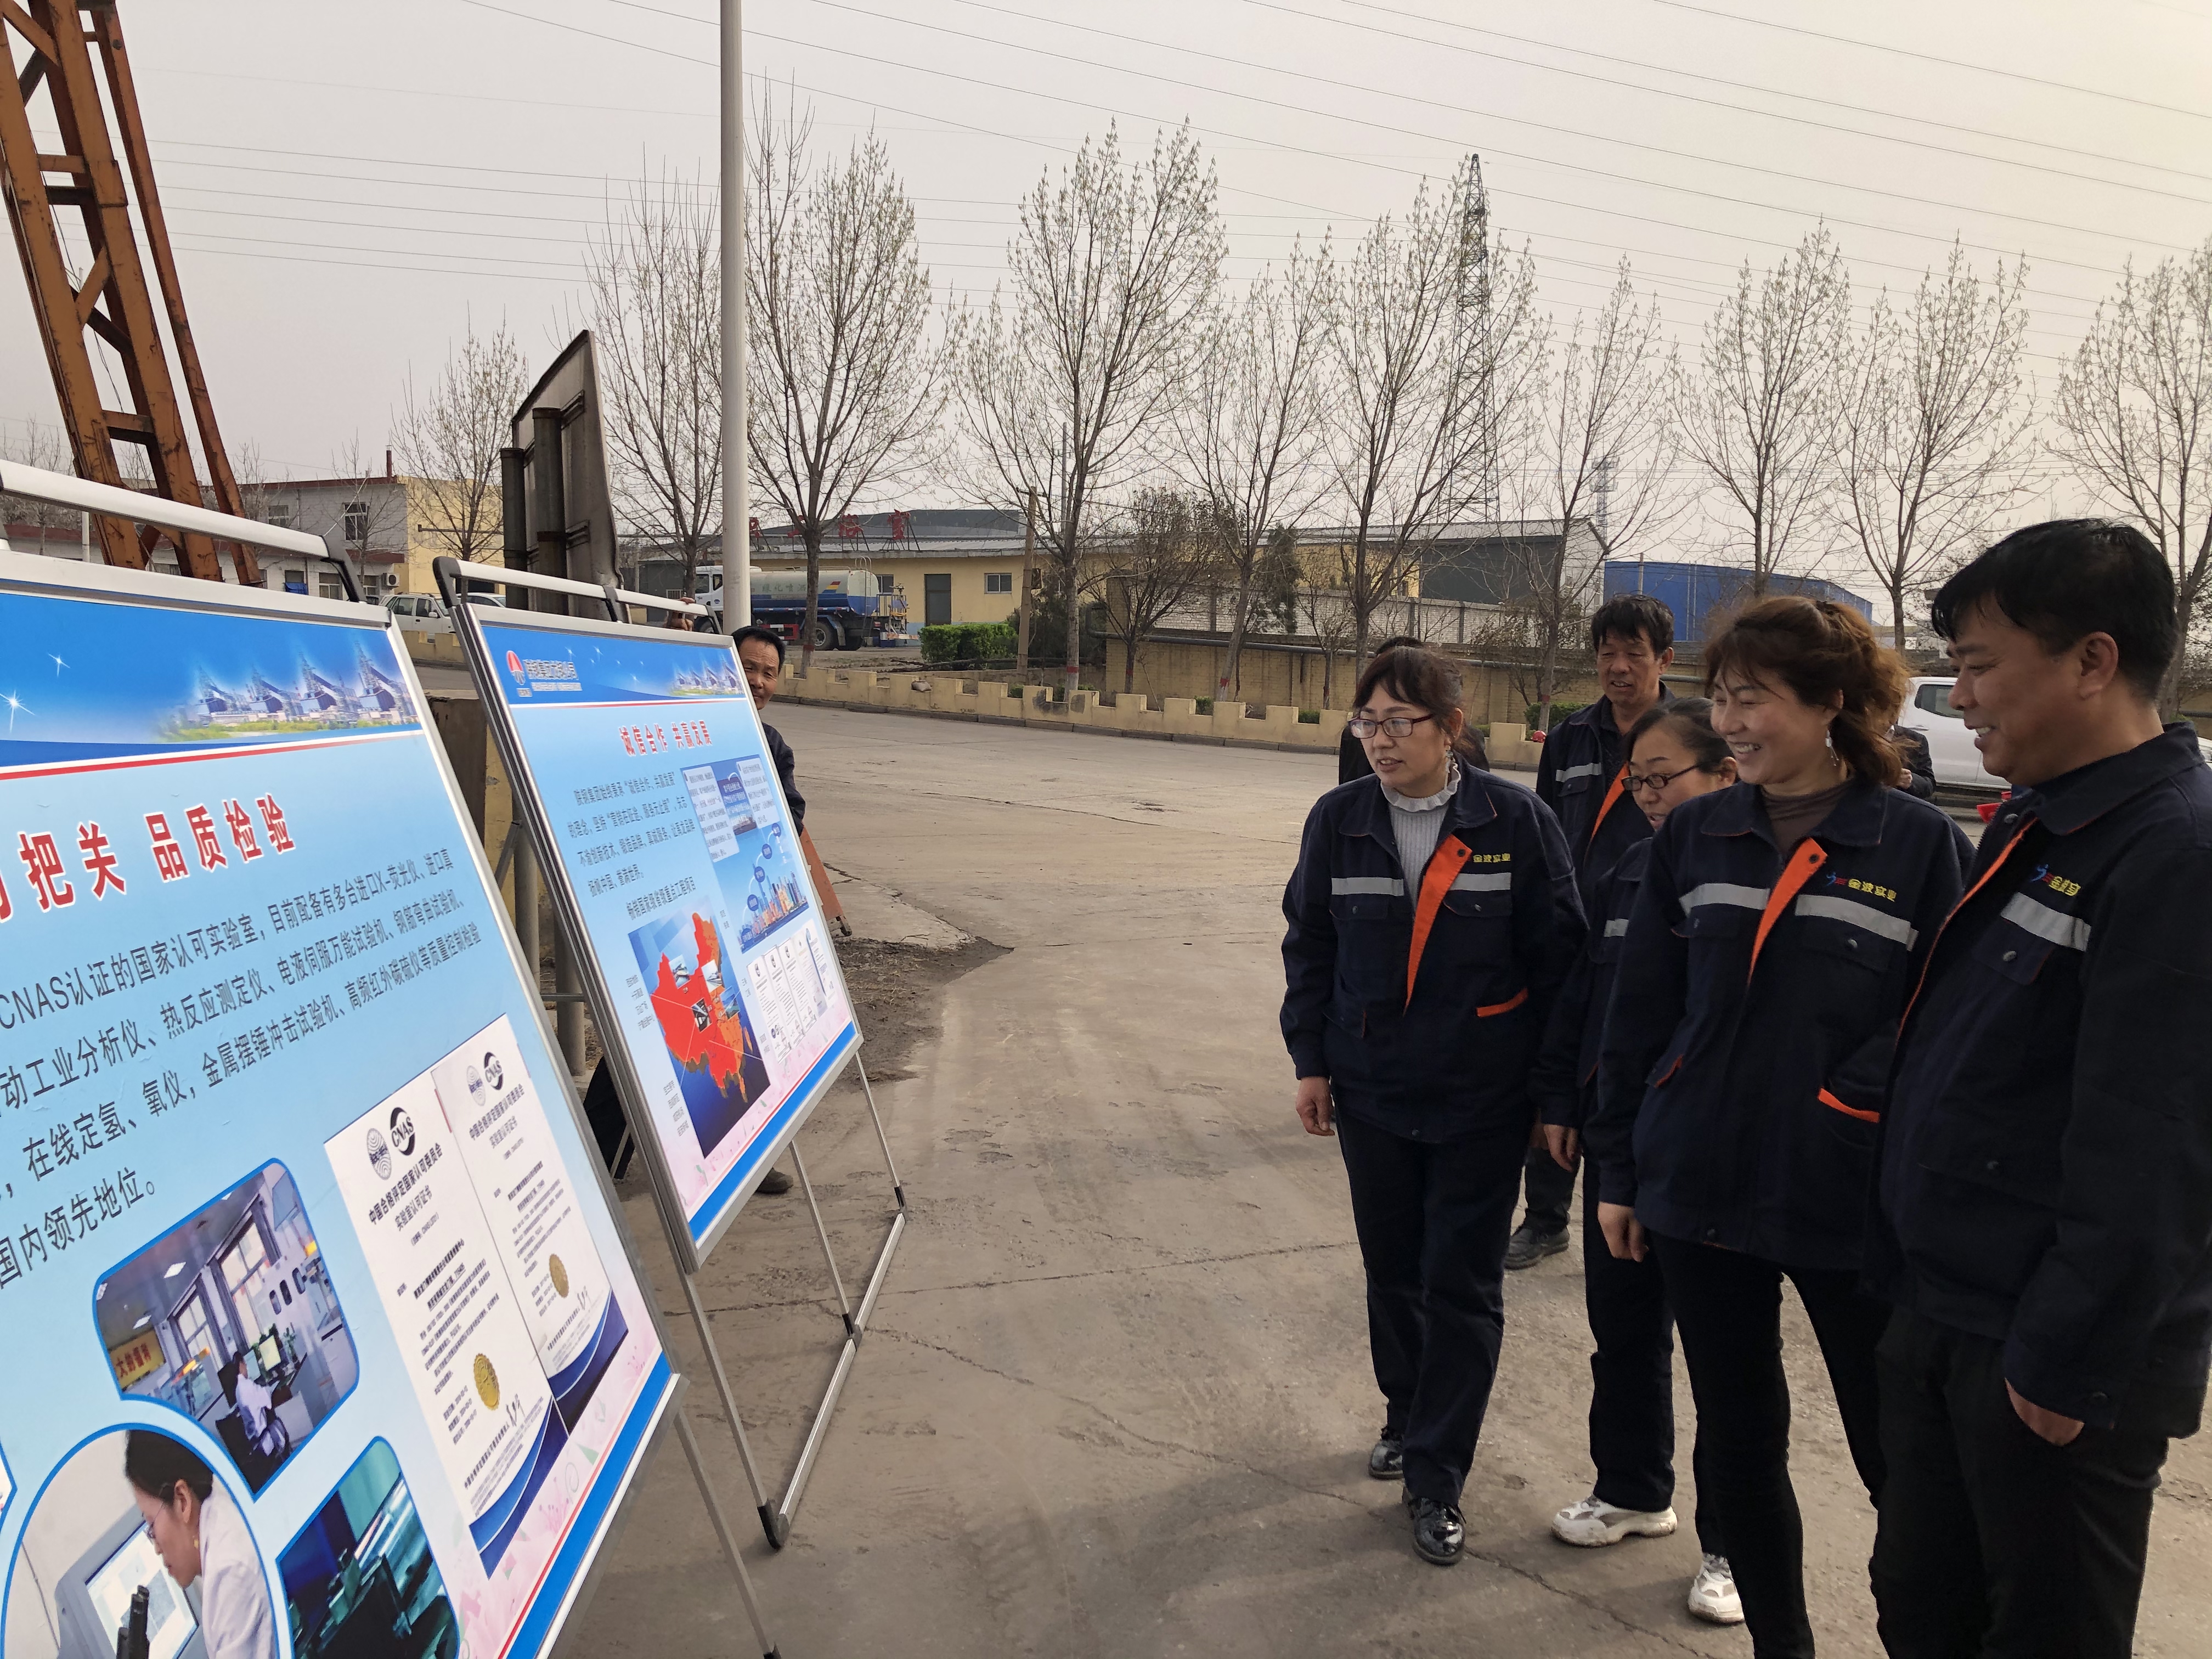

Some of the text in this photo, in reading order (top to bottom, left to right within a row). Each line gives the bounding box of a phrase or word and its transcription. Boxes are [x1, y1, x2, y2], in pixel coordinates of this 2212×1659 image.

[619, 720, 713, 756] 诚信合作 共赢发展
[0, 793, 295, 923] 把关 品质检验
[1848, 878, 1898, 902] 金波实业
[485, 1060, 503, 1083] CNAS
[391, 1116, 414, 1148] CNAS
[369, 1143, 443, 1224] 中国合格评定国家认可委员会
[394, 1184, 433, 1232] 实验室认可证书
